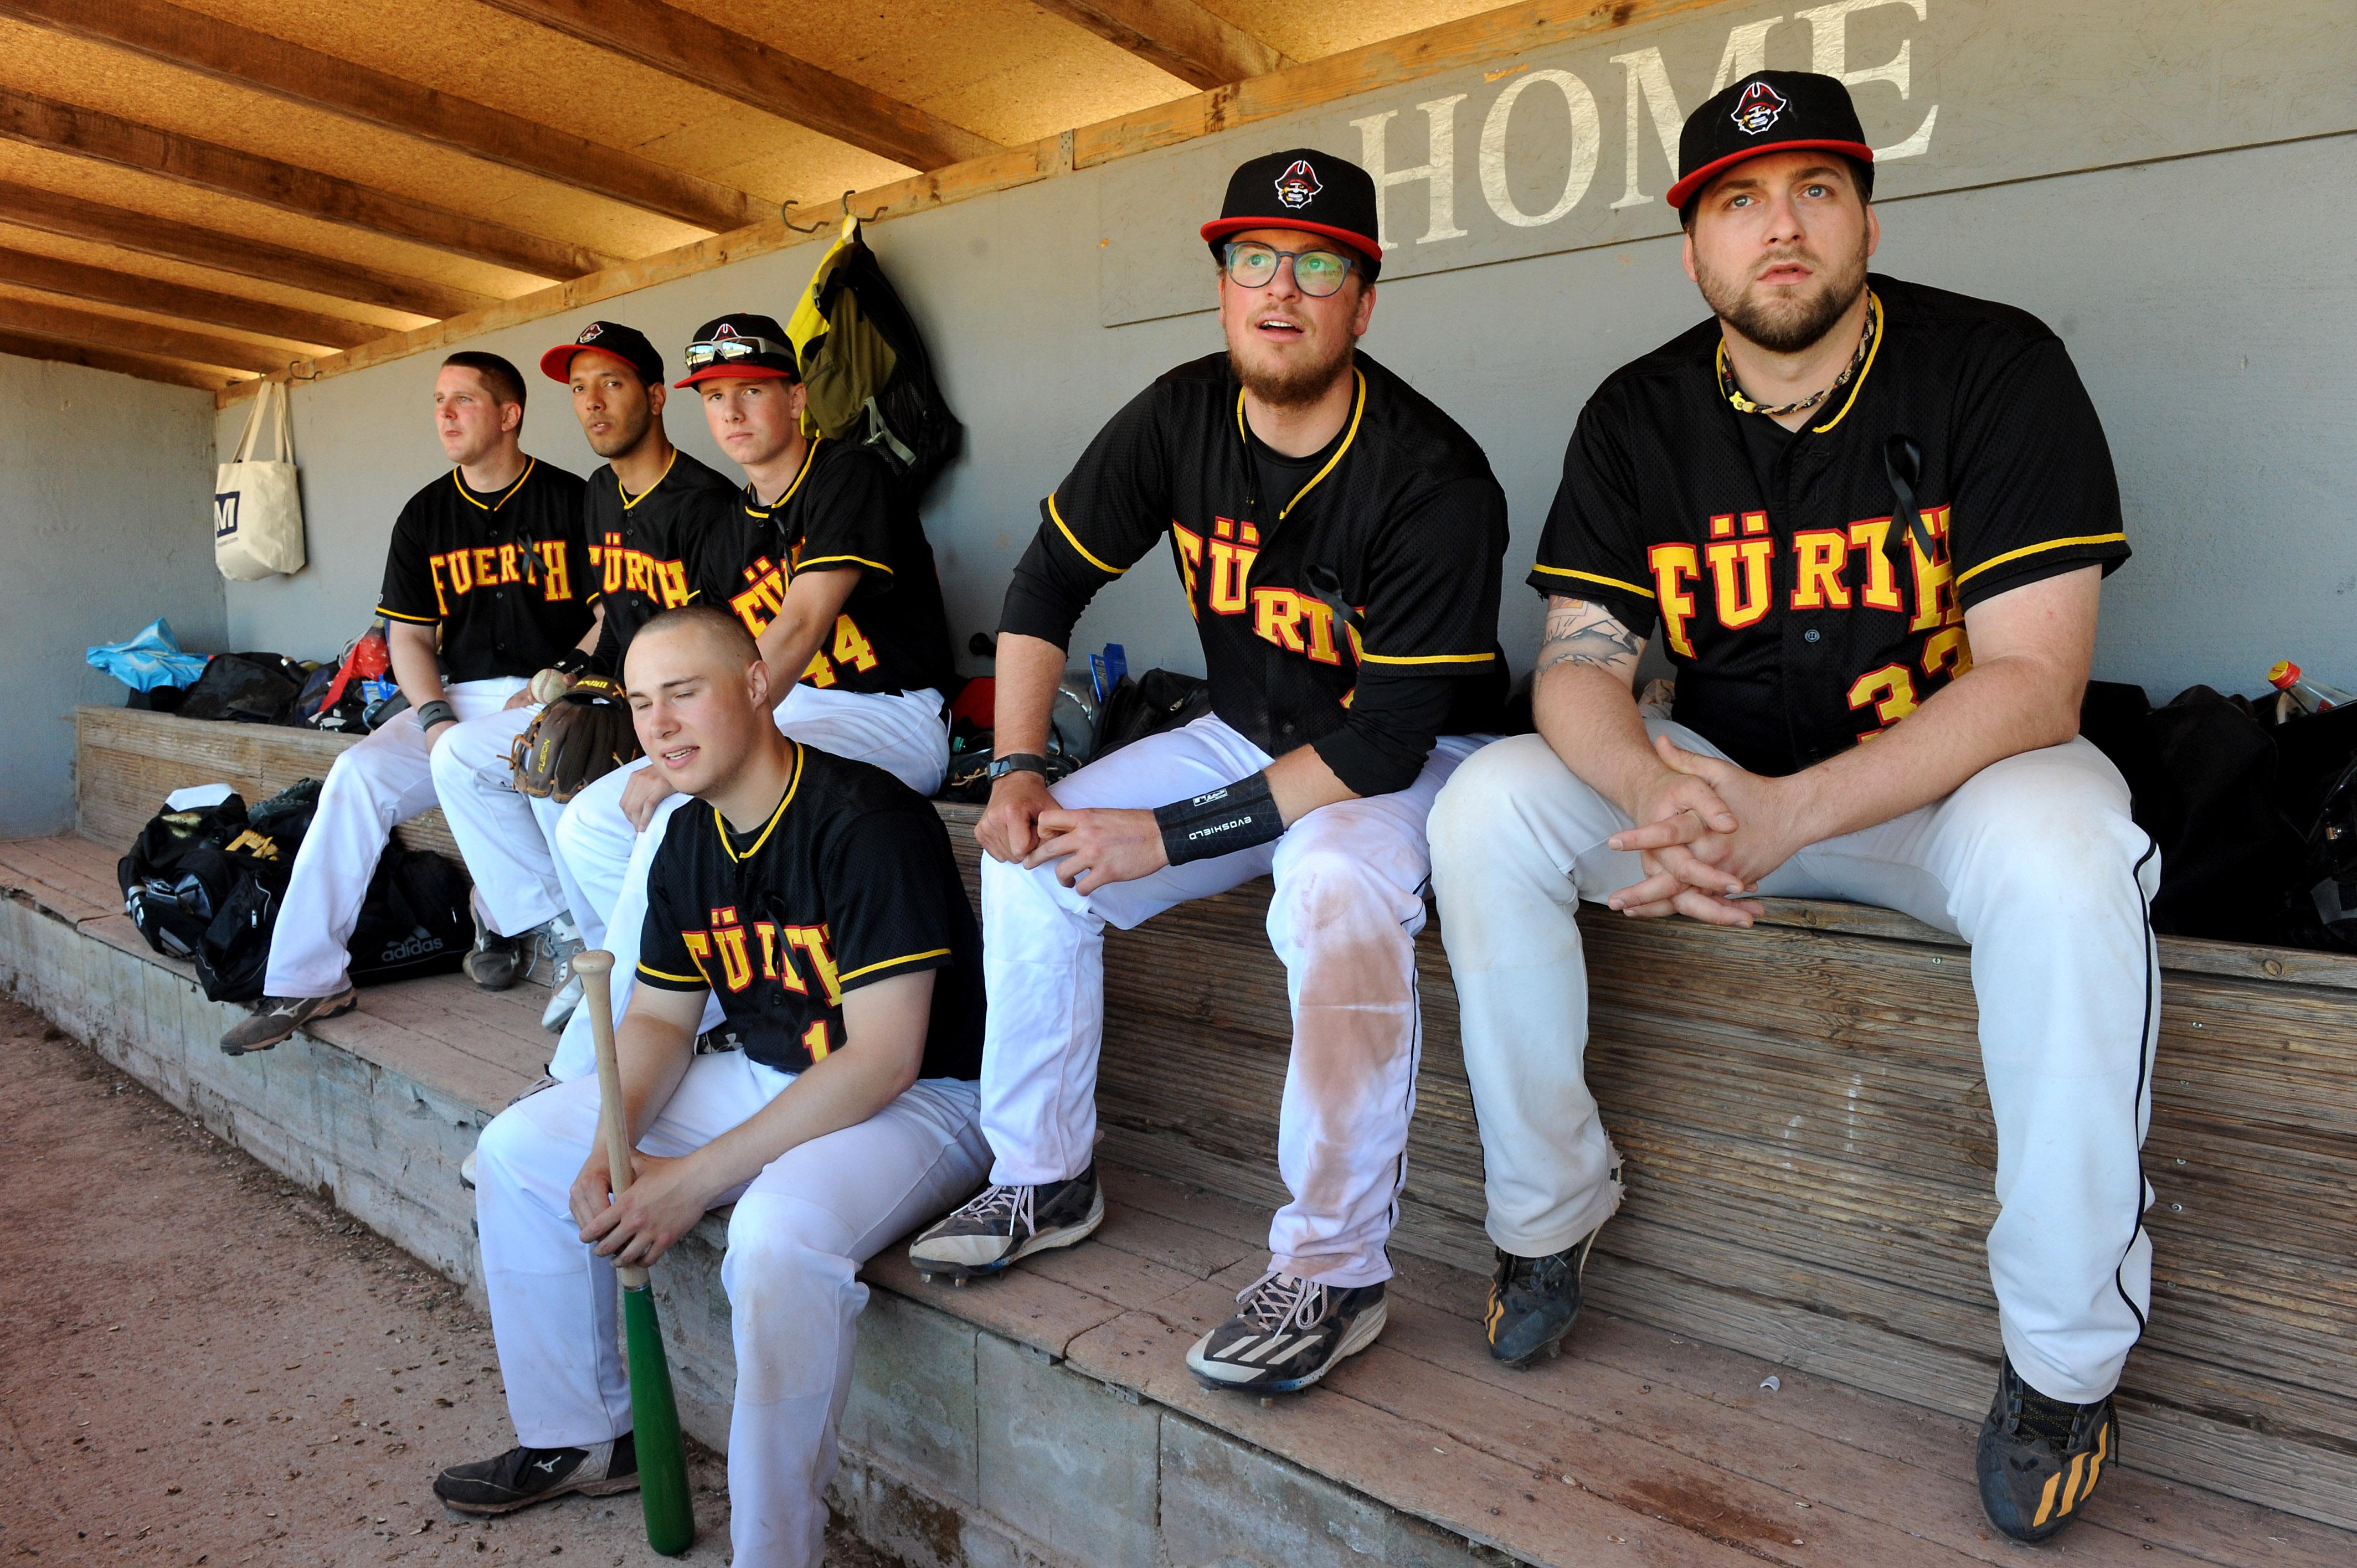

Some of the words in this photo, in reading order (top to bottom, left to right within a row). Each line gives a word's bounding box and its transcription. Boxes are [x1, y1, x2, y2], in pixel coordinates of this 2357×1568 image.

[1349, 0, 1939, 251] HOME
[1171, 516, 1366, 668] FÜRT
[538, 738, 550, 773] FUSION
[381, 937, 443, 962] adidas
